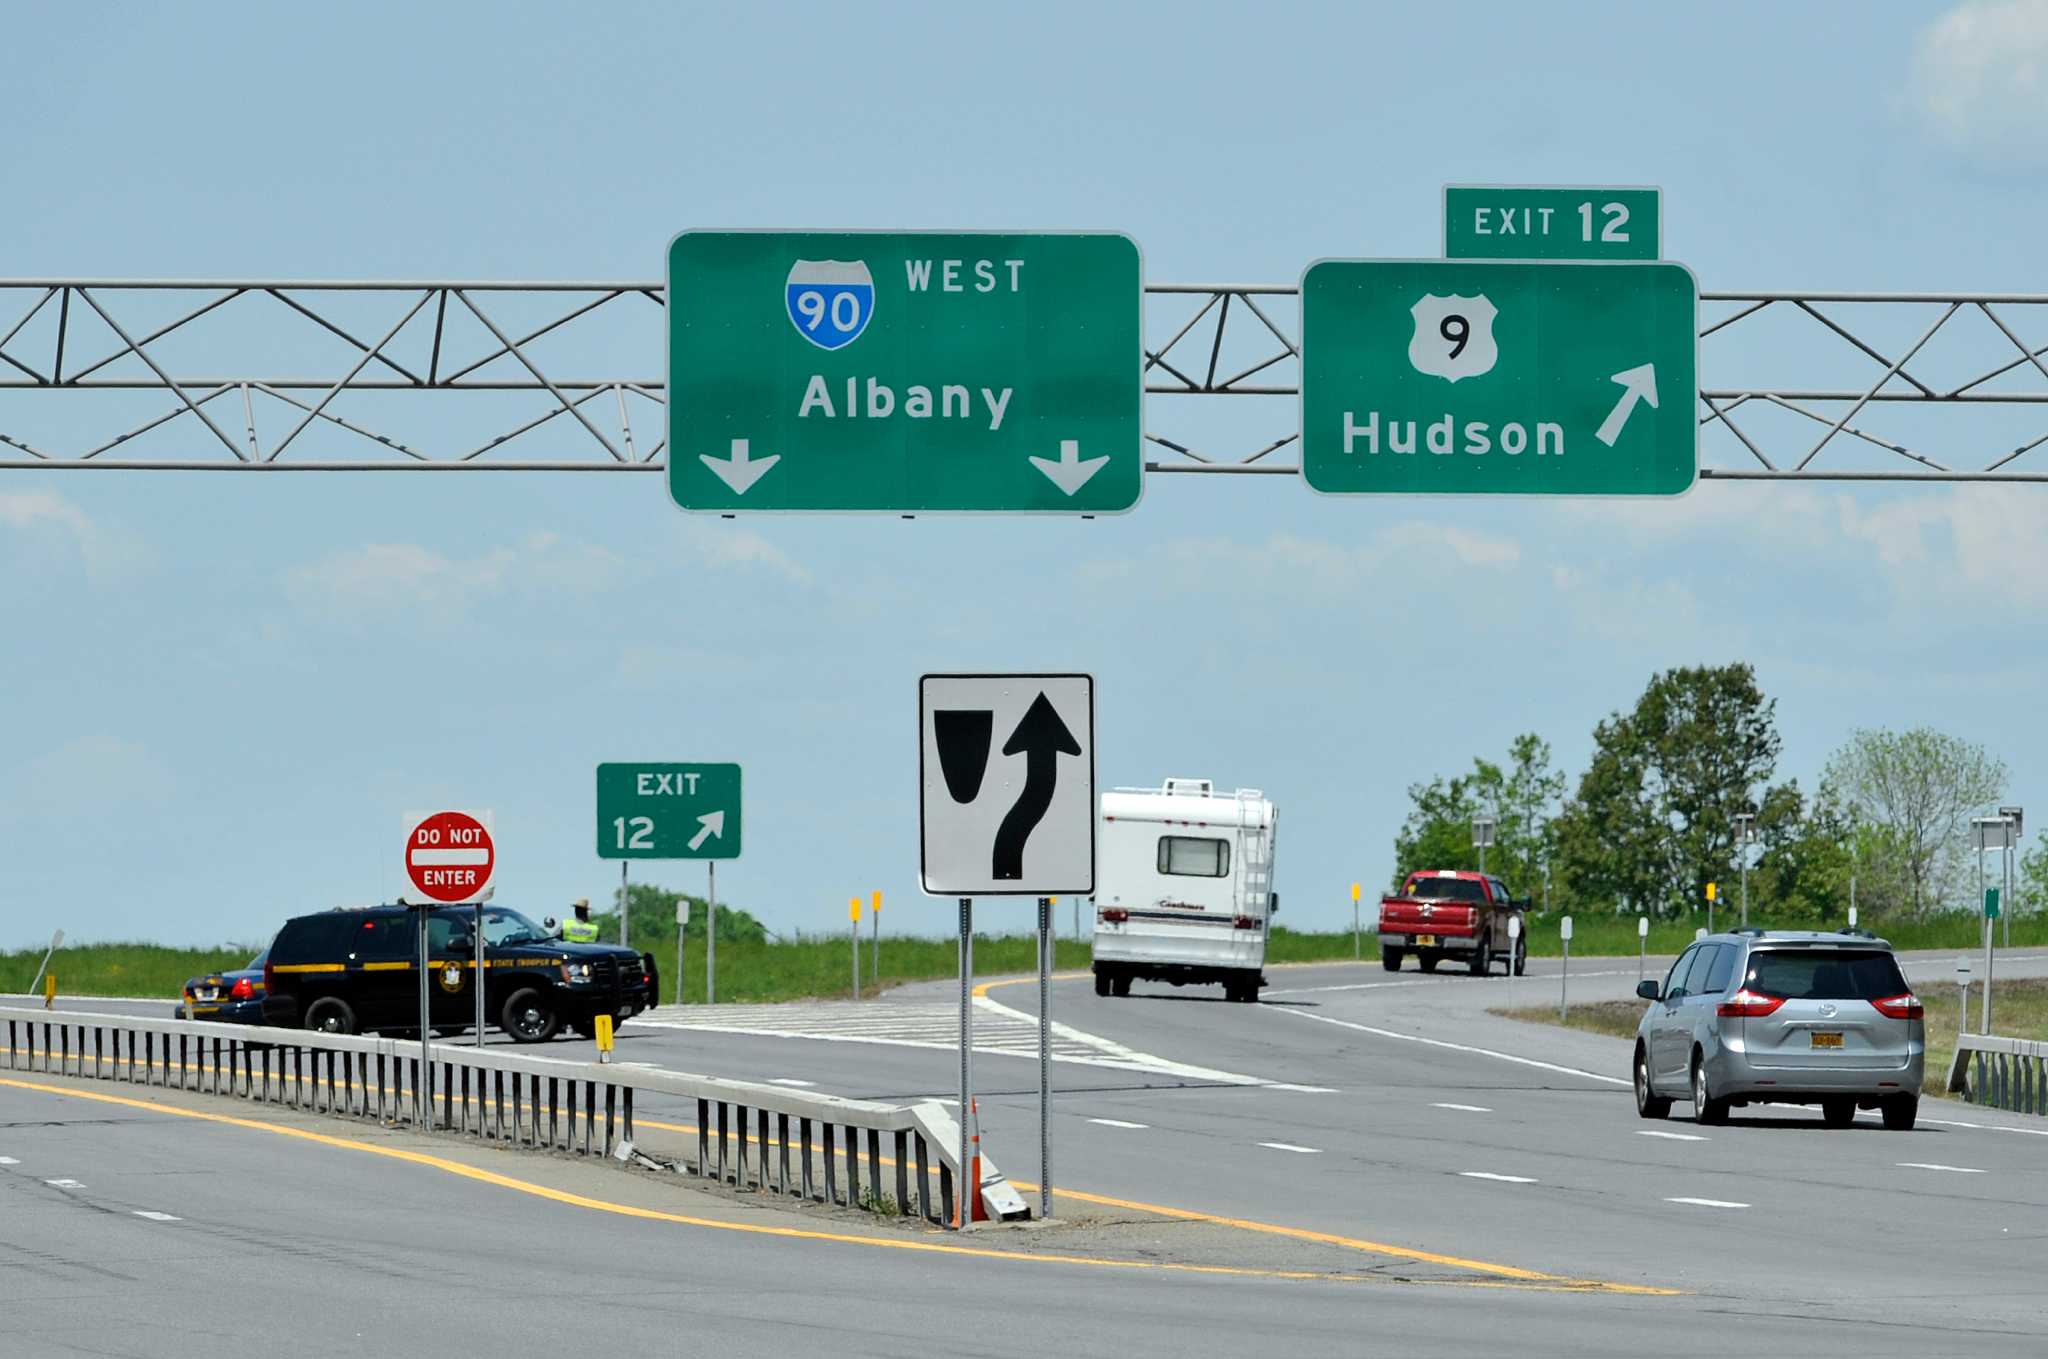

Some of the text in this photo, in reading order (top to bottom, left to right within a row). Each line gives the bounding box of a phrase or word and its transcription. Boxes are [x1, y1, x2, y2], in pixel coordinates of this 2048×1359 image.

[1475, 202, 1630, 242] EXIT 12
[905, 259, 1025, 292] WEST
[797, 291, 861, 333] 90
[1440, 314, 1470, 360] 9
[798, 375, 1013, 430] Albany
[1343, 411, 1564, 455] Hudson
[637, 773, 701, 796] EXIT
[417, 828, 482, 844] DO NOT
[613, 816, 655, 849] 12
[423, 870, 476, 886] ENTER
